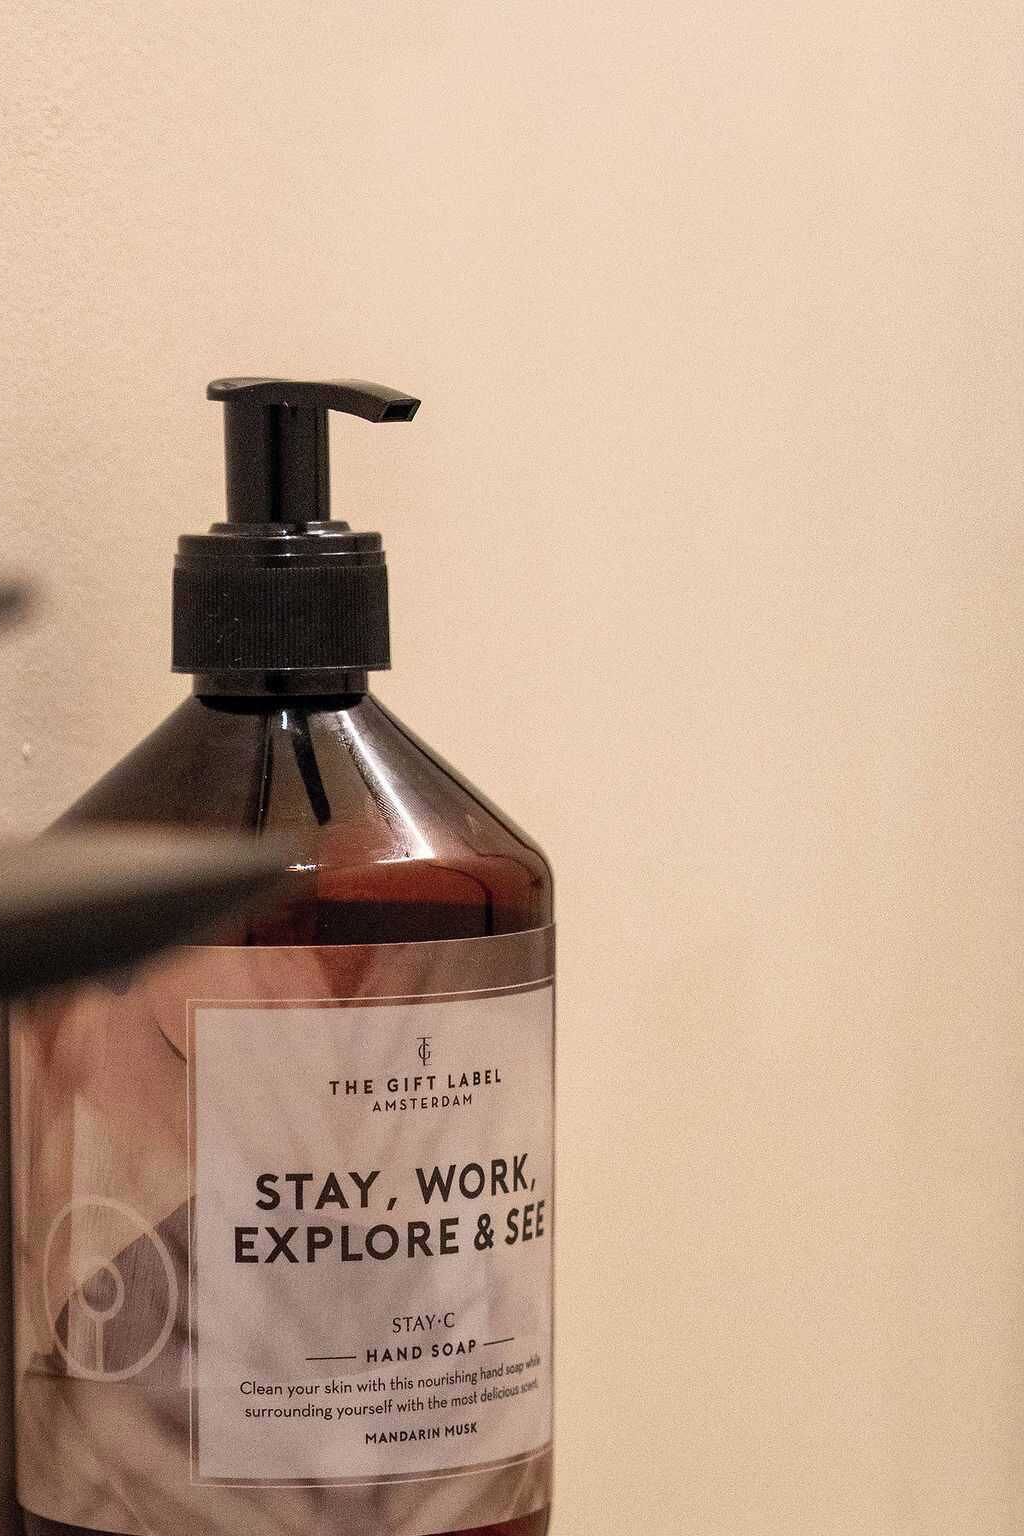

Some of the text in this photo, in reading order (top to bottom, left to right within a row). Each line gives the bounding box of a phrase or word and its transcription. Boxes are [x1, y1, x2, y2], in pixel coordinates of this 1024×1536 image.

[329, 1069, 502, 1096] THE GIFT LABEL
[372, 1094, 473, 1112] AMSTERDAM
[255, 1152, 536, 1211] STAY, WORK,
[234, 1200, 546, 1264] EXPLORE & SEE
[366, 1339, 477, 1364] HAND SOAP
[239, 1381, 283, 1396] Clean
[287, 1384, 321, 1399] your
[324, 1379, 352, 1395] skin
[356, 1377, 386, 1393] with
[390, 1376, 414, 1391] this
[417, 1369, 478, 1388] nourishing
[480, 1362, 504, 1381] hand
[244, 1403, 333, 1421] surrounding
[336, 1399, 393, 1420] yourself
[396, 1397, 424, 1413] with
[428, 1394, 448, 1410] the
[450, 1391, 478, 1407] most
[365, 1422, 478, 1445] MANDARIN MUSK
